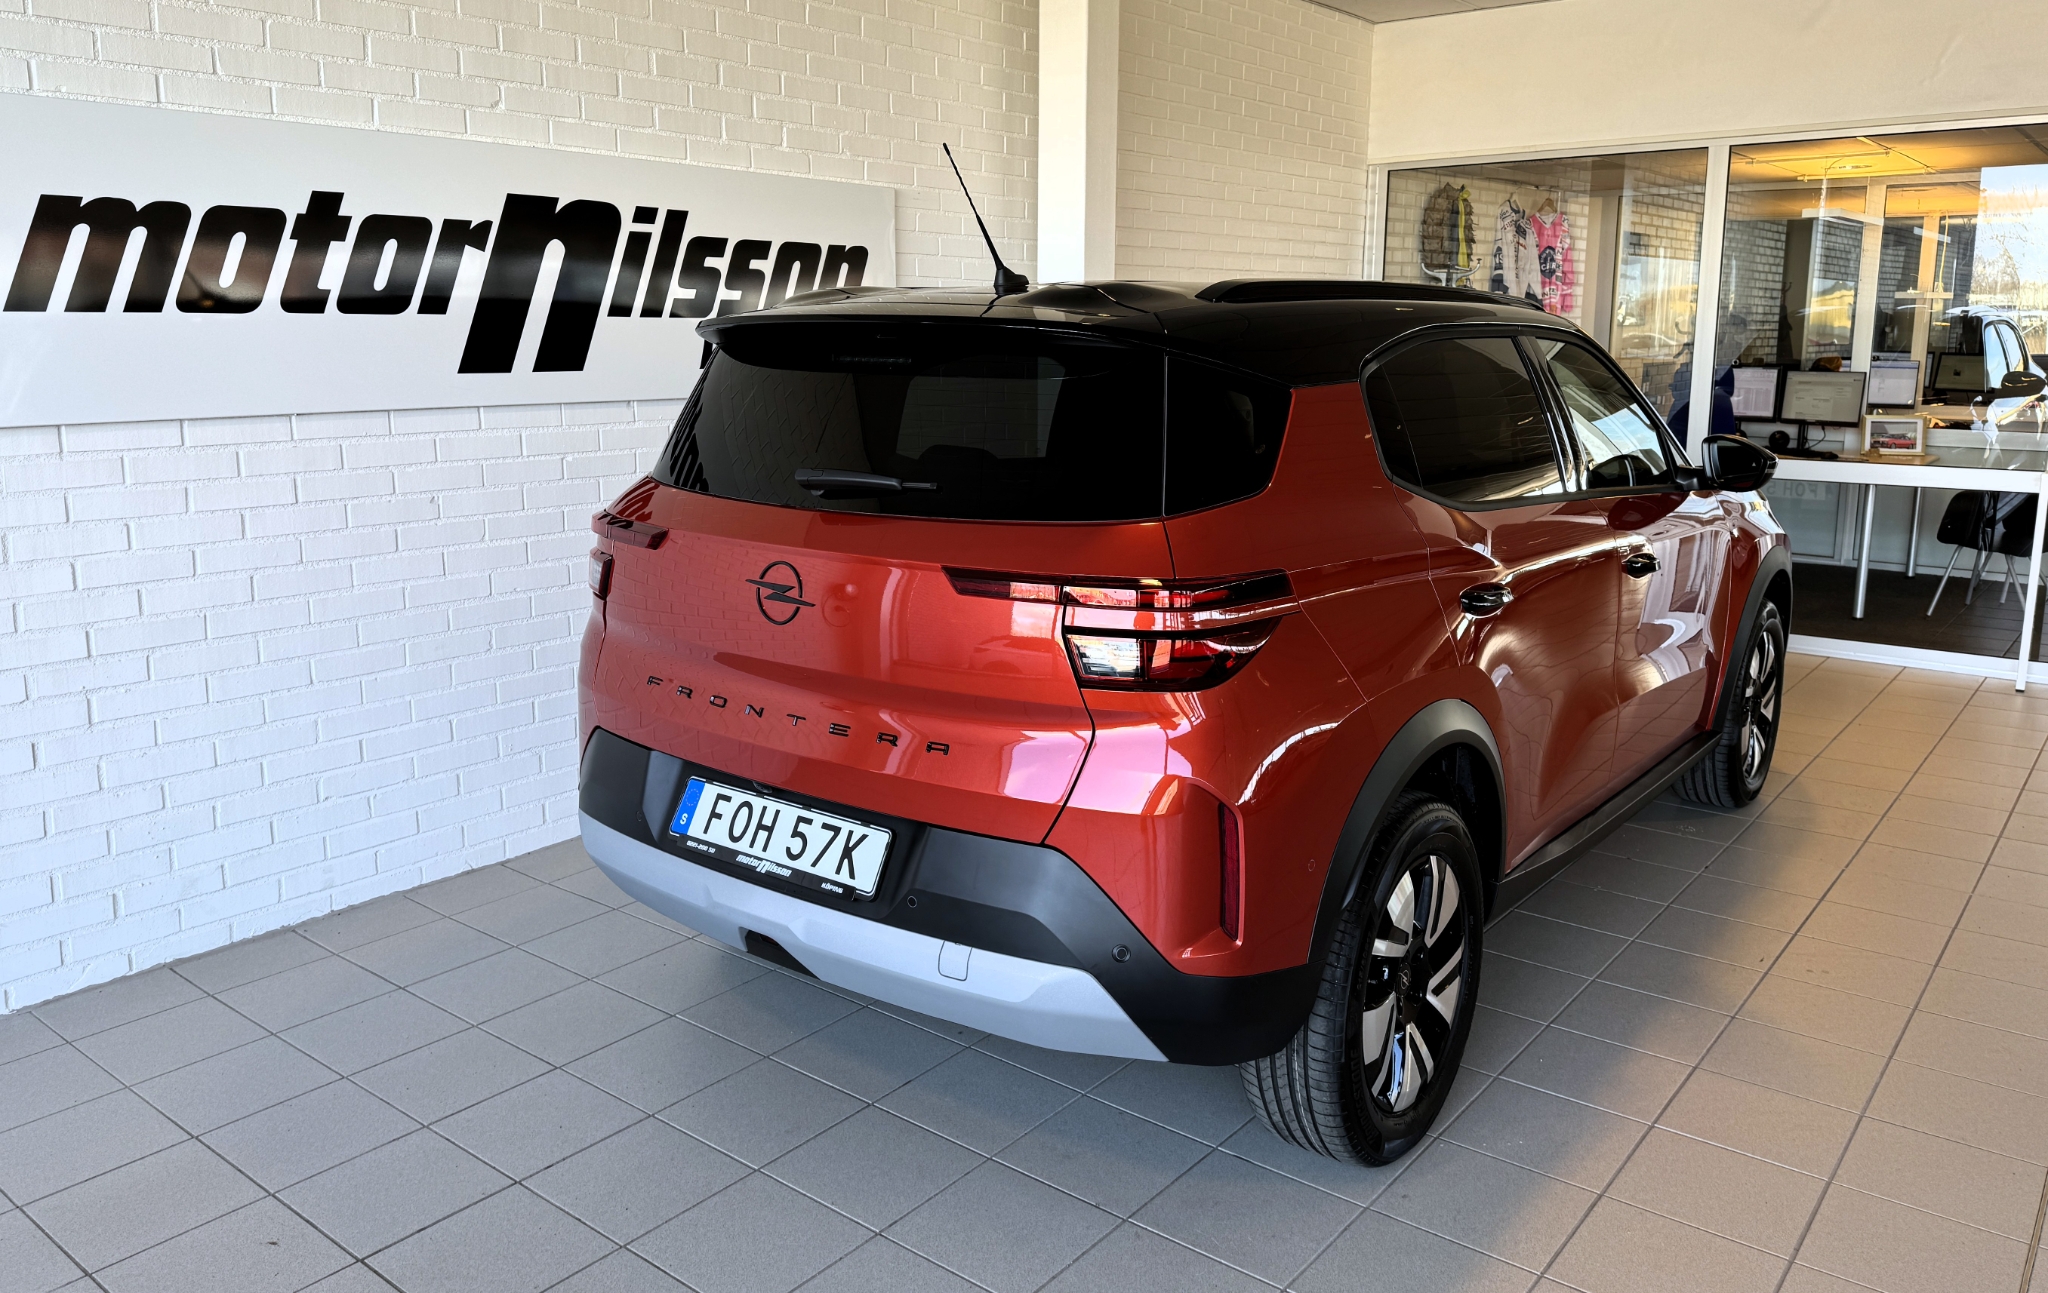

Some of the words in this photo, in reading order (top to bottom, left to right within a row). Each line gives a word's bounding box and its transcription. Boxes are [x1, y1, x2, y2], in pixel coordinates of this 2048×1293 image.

[646, 675, 950, 756] FRONTERA
[679, 813, 688, 825] S
[702, 793, 781, 853] FOH
[785, 815, 870, 881] 57K
